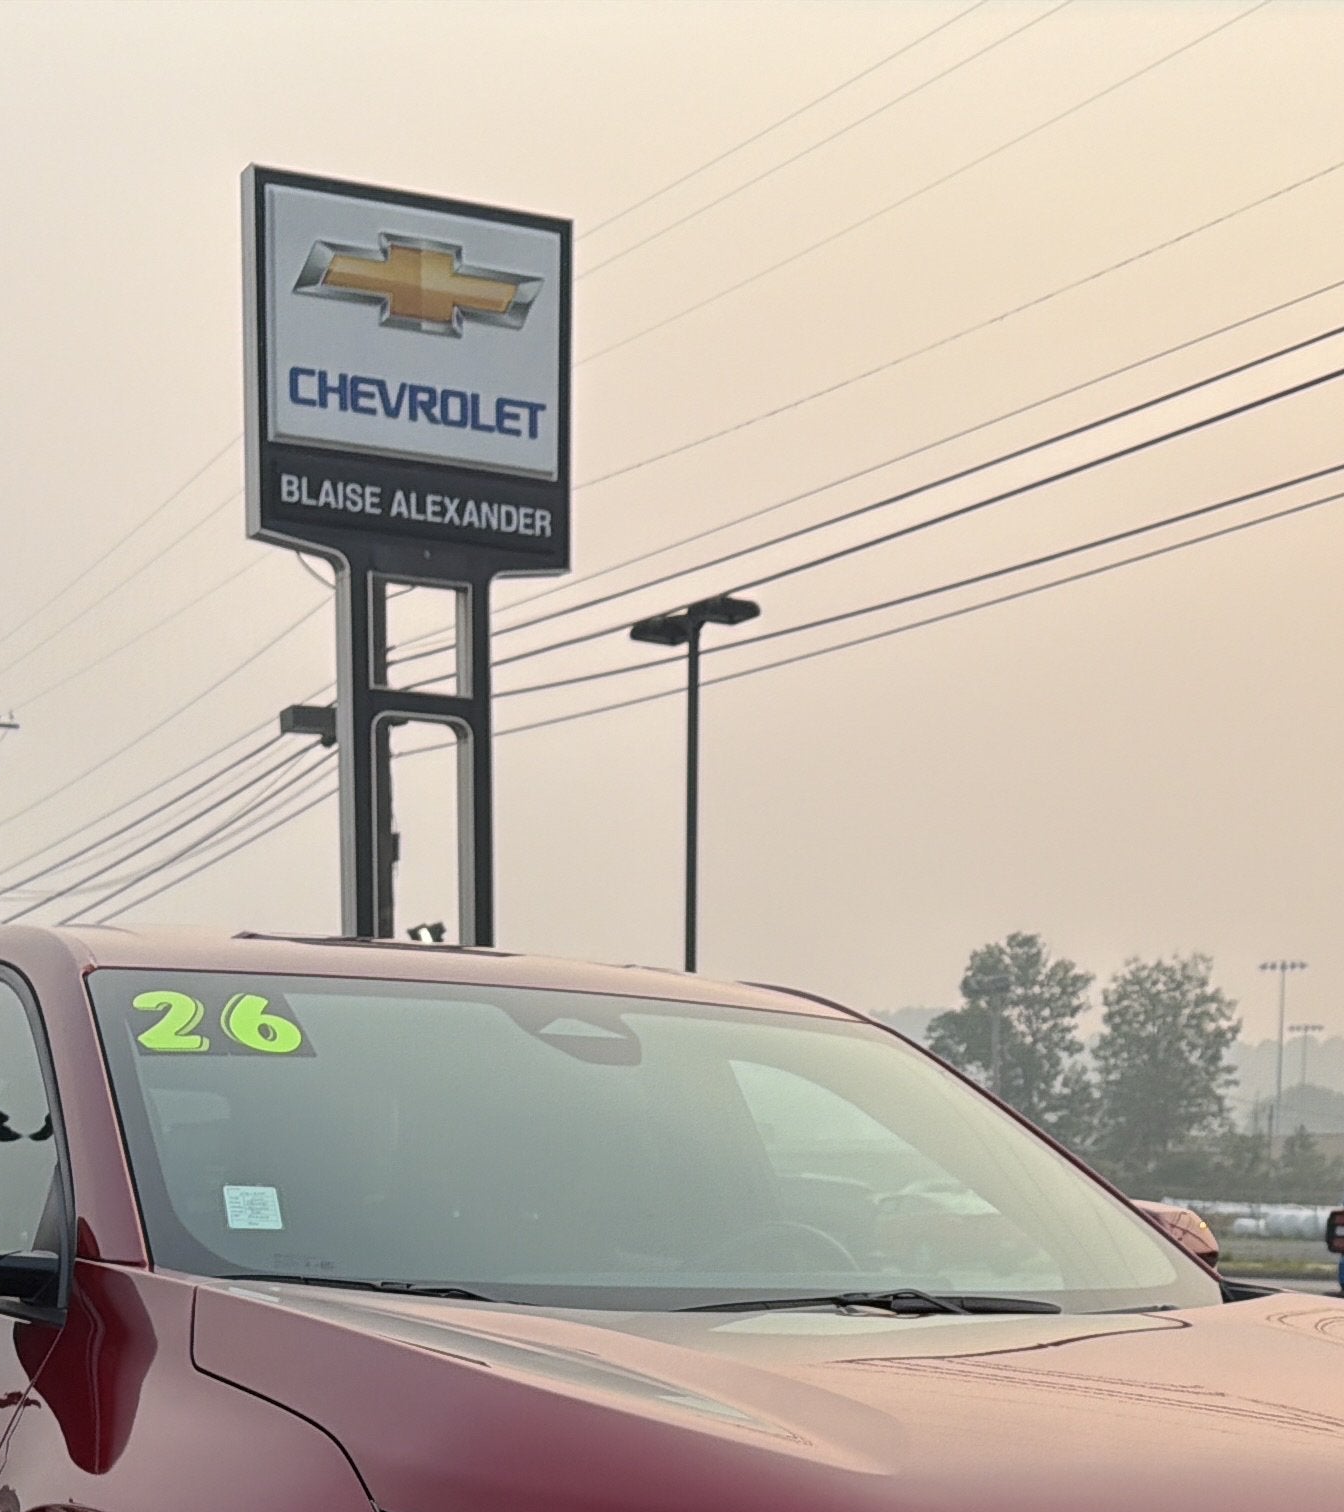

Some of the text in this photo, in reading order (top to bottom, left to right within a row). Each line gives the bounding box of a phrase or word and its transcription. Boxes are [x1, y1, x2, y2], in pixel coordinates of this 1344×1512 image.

[289, 366, 546, 439] CHEVROLET
[280, 473, 552, 538] BLAISE ALEXANDER
[132, 991, 302, 1053] 26
